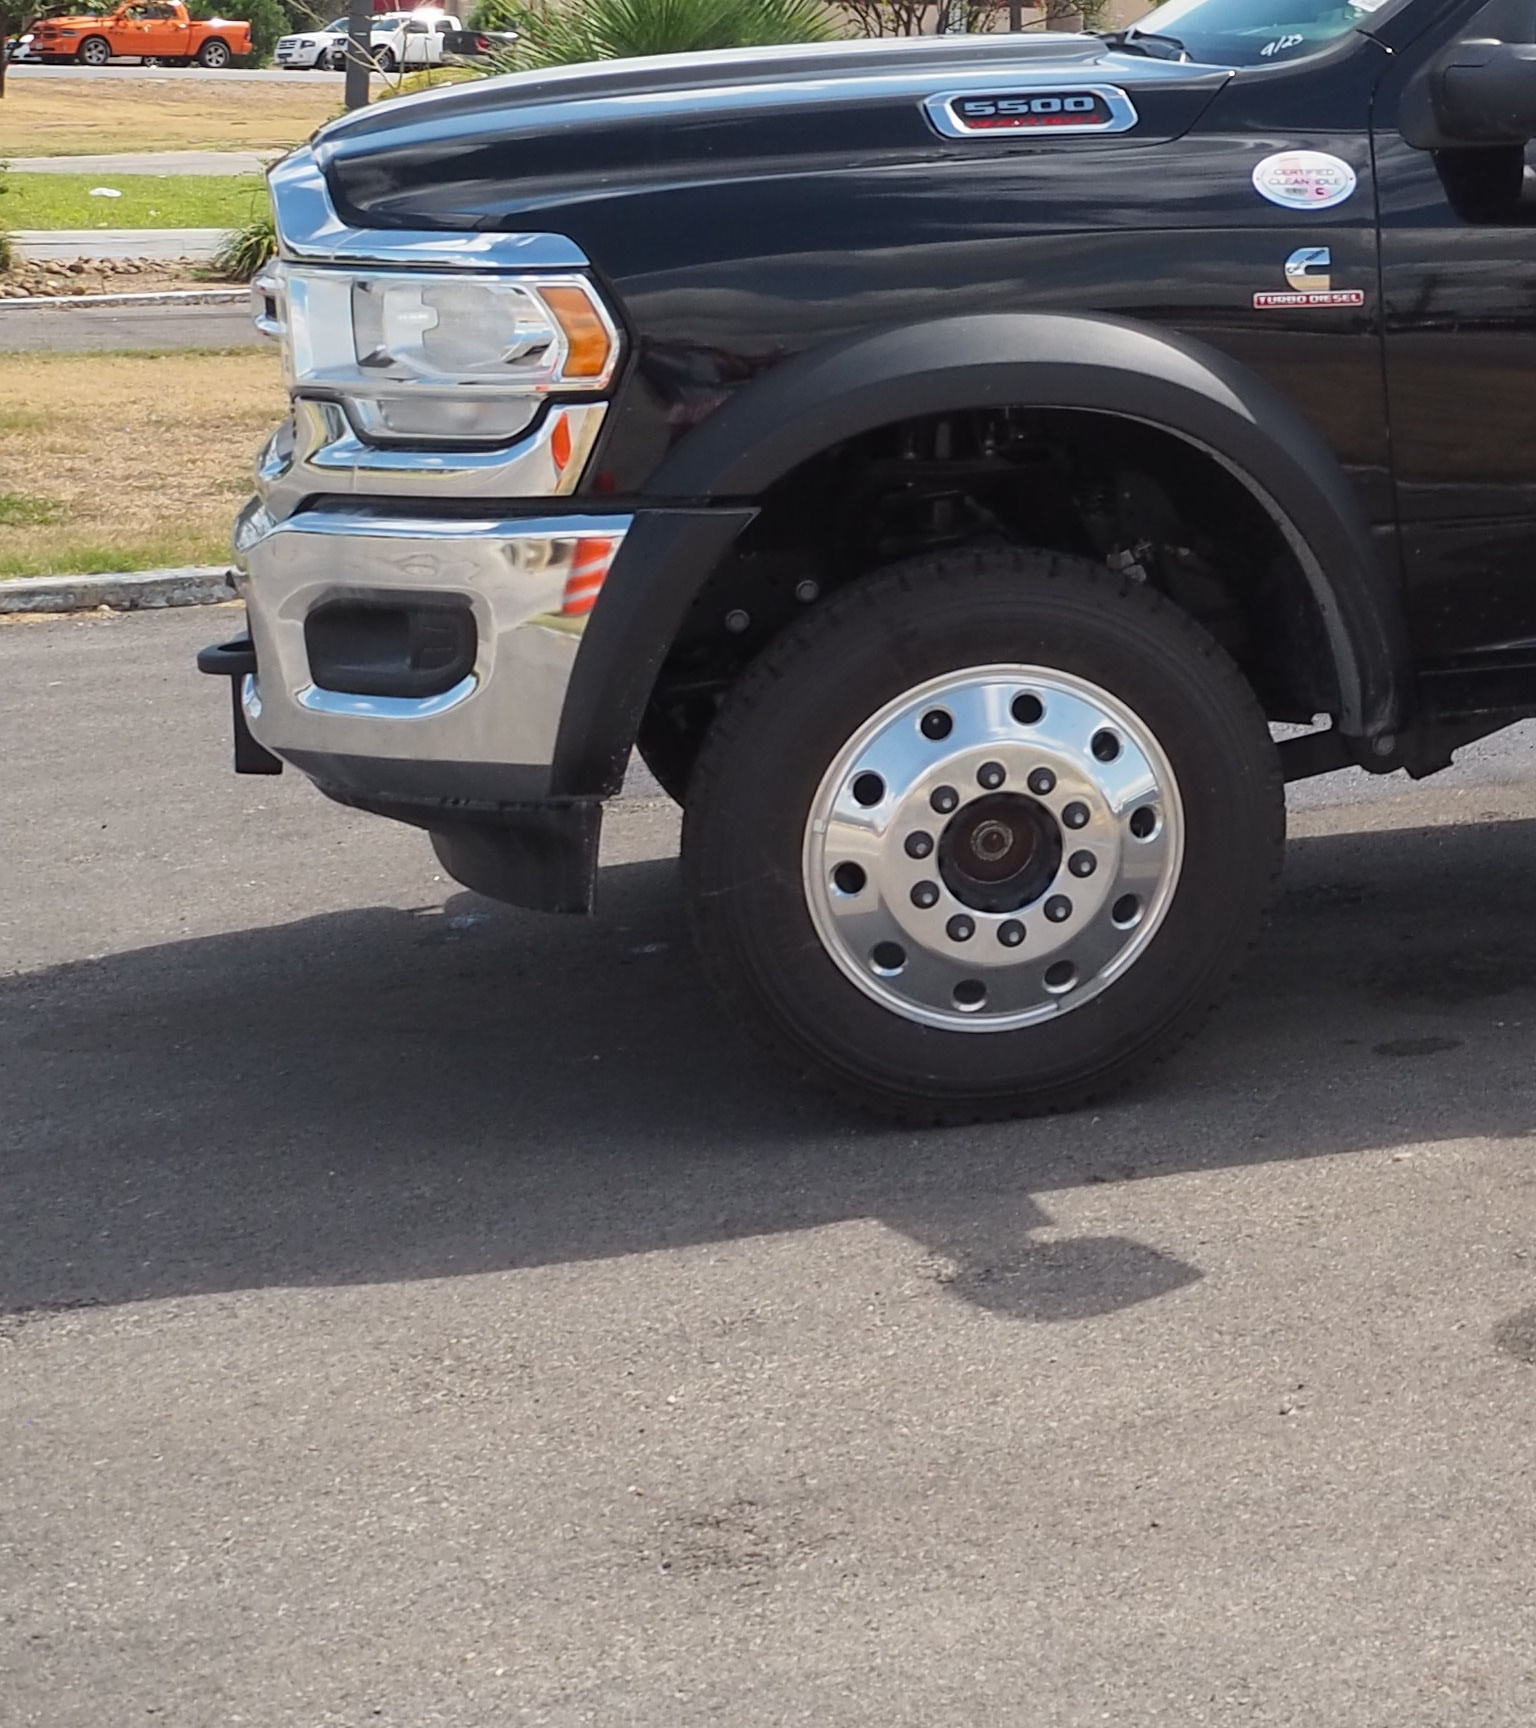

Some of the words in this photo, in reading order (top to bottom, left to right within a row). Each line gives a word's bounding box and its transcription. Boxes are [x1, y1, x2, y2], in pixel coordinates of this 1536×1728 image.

[964, 97, 1095, 116] 5500
[1257, 294, 1307, 305] TURBO
[1308, 292, 1360, 304] DIESEL
